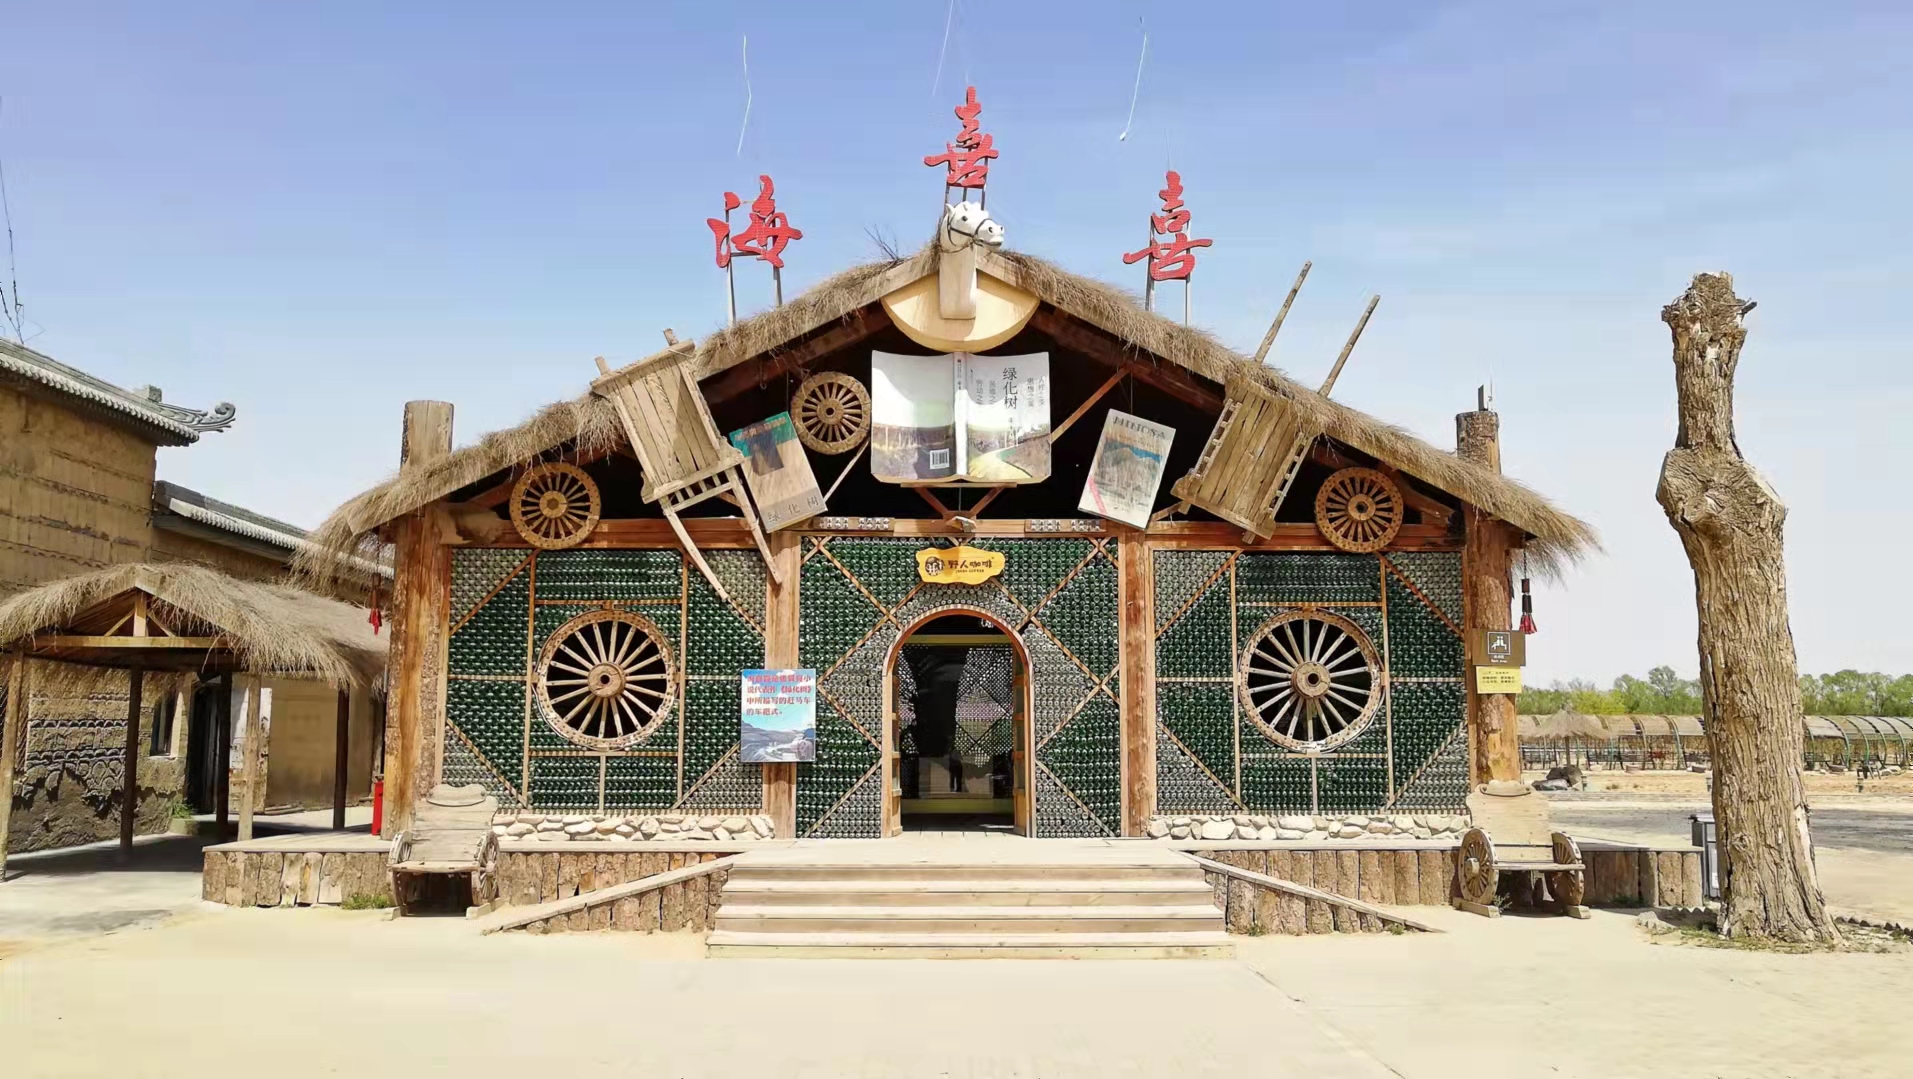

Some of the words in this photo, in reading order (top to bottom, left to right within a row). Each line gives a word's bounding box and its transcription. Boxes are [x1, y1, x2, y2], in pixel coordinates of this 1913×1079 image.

[707, 174, 803, 269] 海
[924, 86, 999, 188] 喜
[1123, 170, 1213, 281] 喜
[1002, 367, 1018, 410] 绿化树
[948, 559, 993, 569] 野人咖啡
